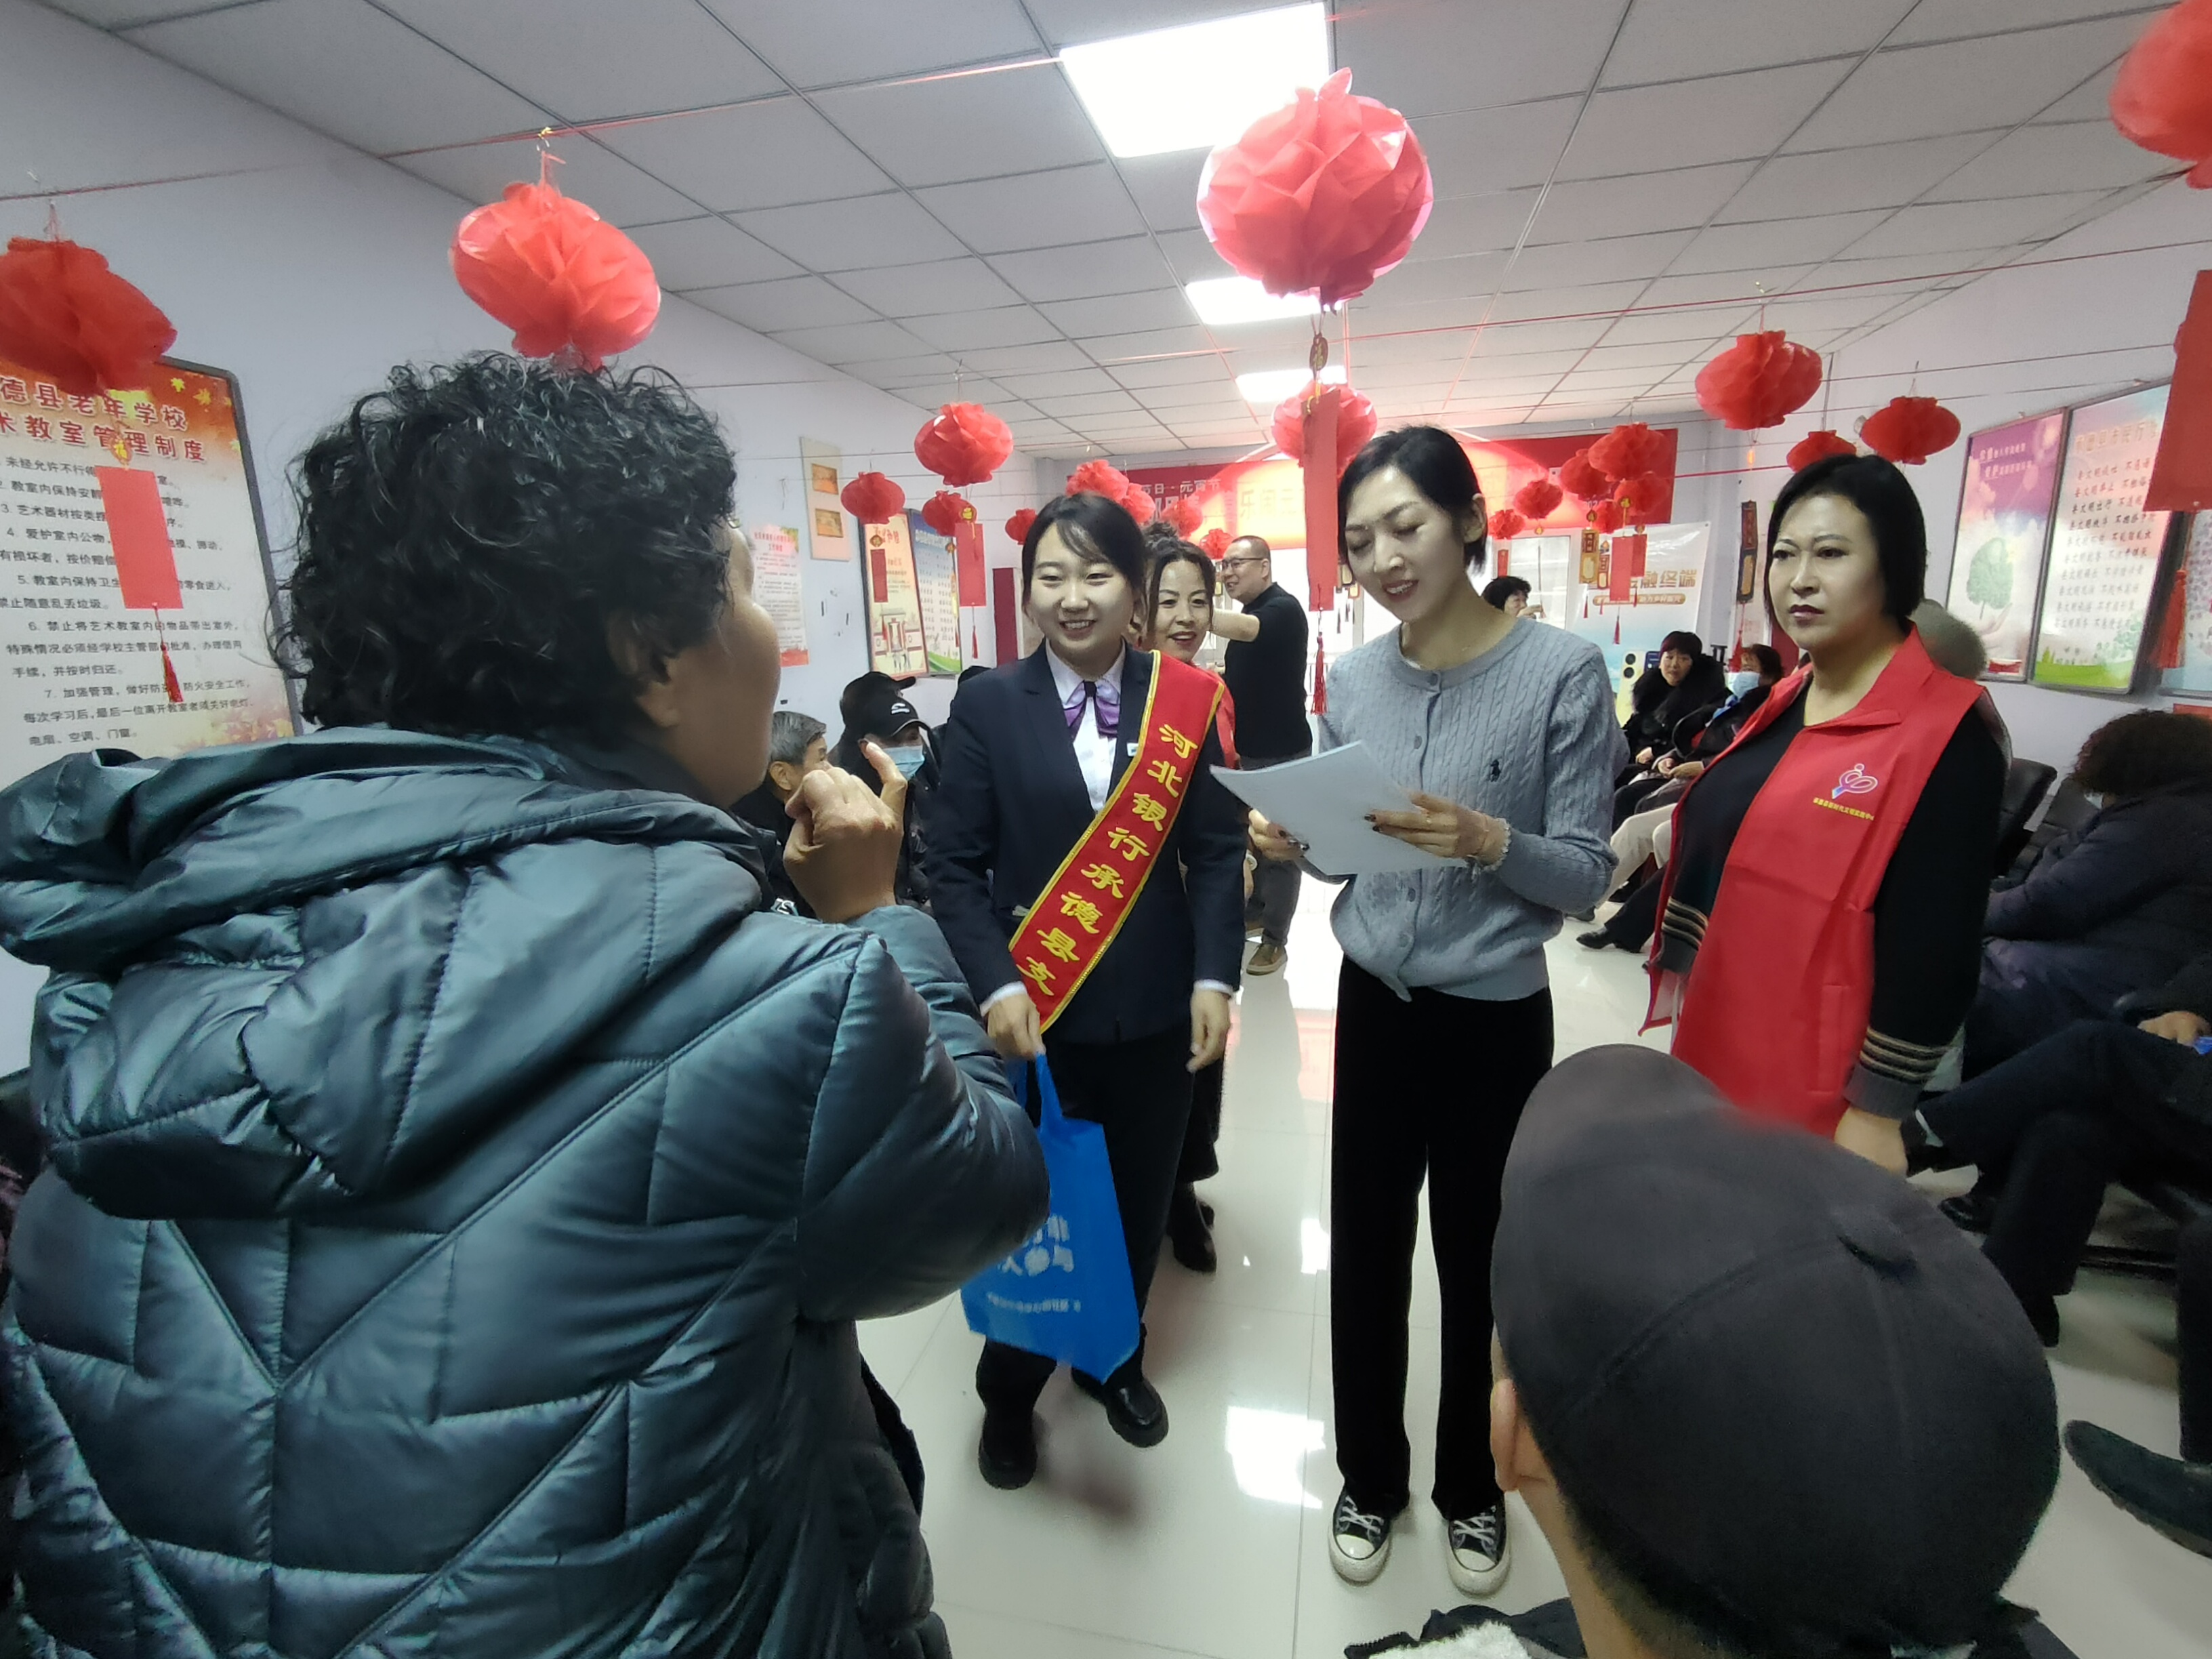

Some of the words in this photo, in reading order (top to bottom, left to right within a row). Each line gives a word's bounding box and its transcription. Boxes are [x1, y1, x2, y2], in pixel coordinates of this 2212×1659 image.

[0, 377, 186, 430] 德县老年学校
[0, 412, 204, 461] 术教室管理制度
[1017, 723, 1198, 996] 河北银行承德县支
